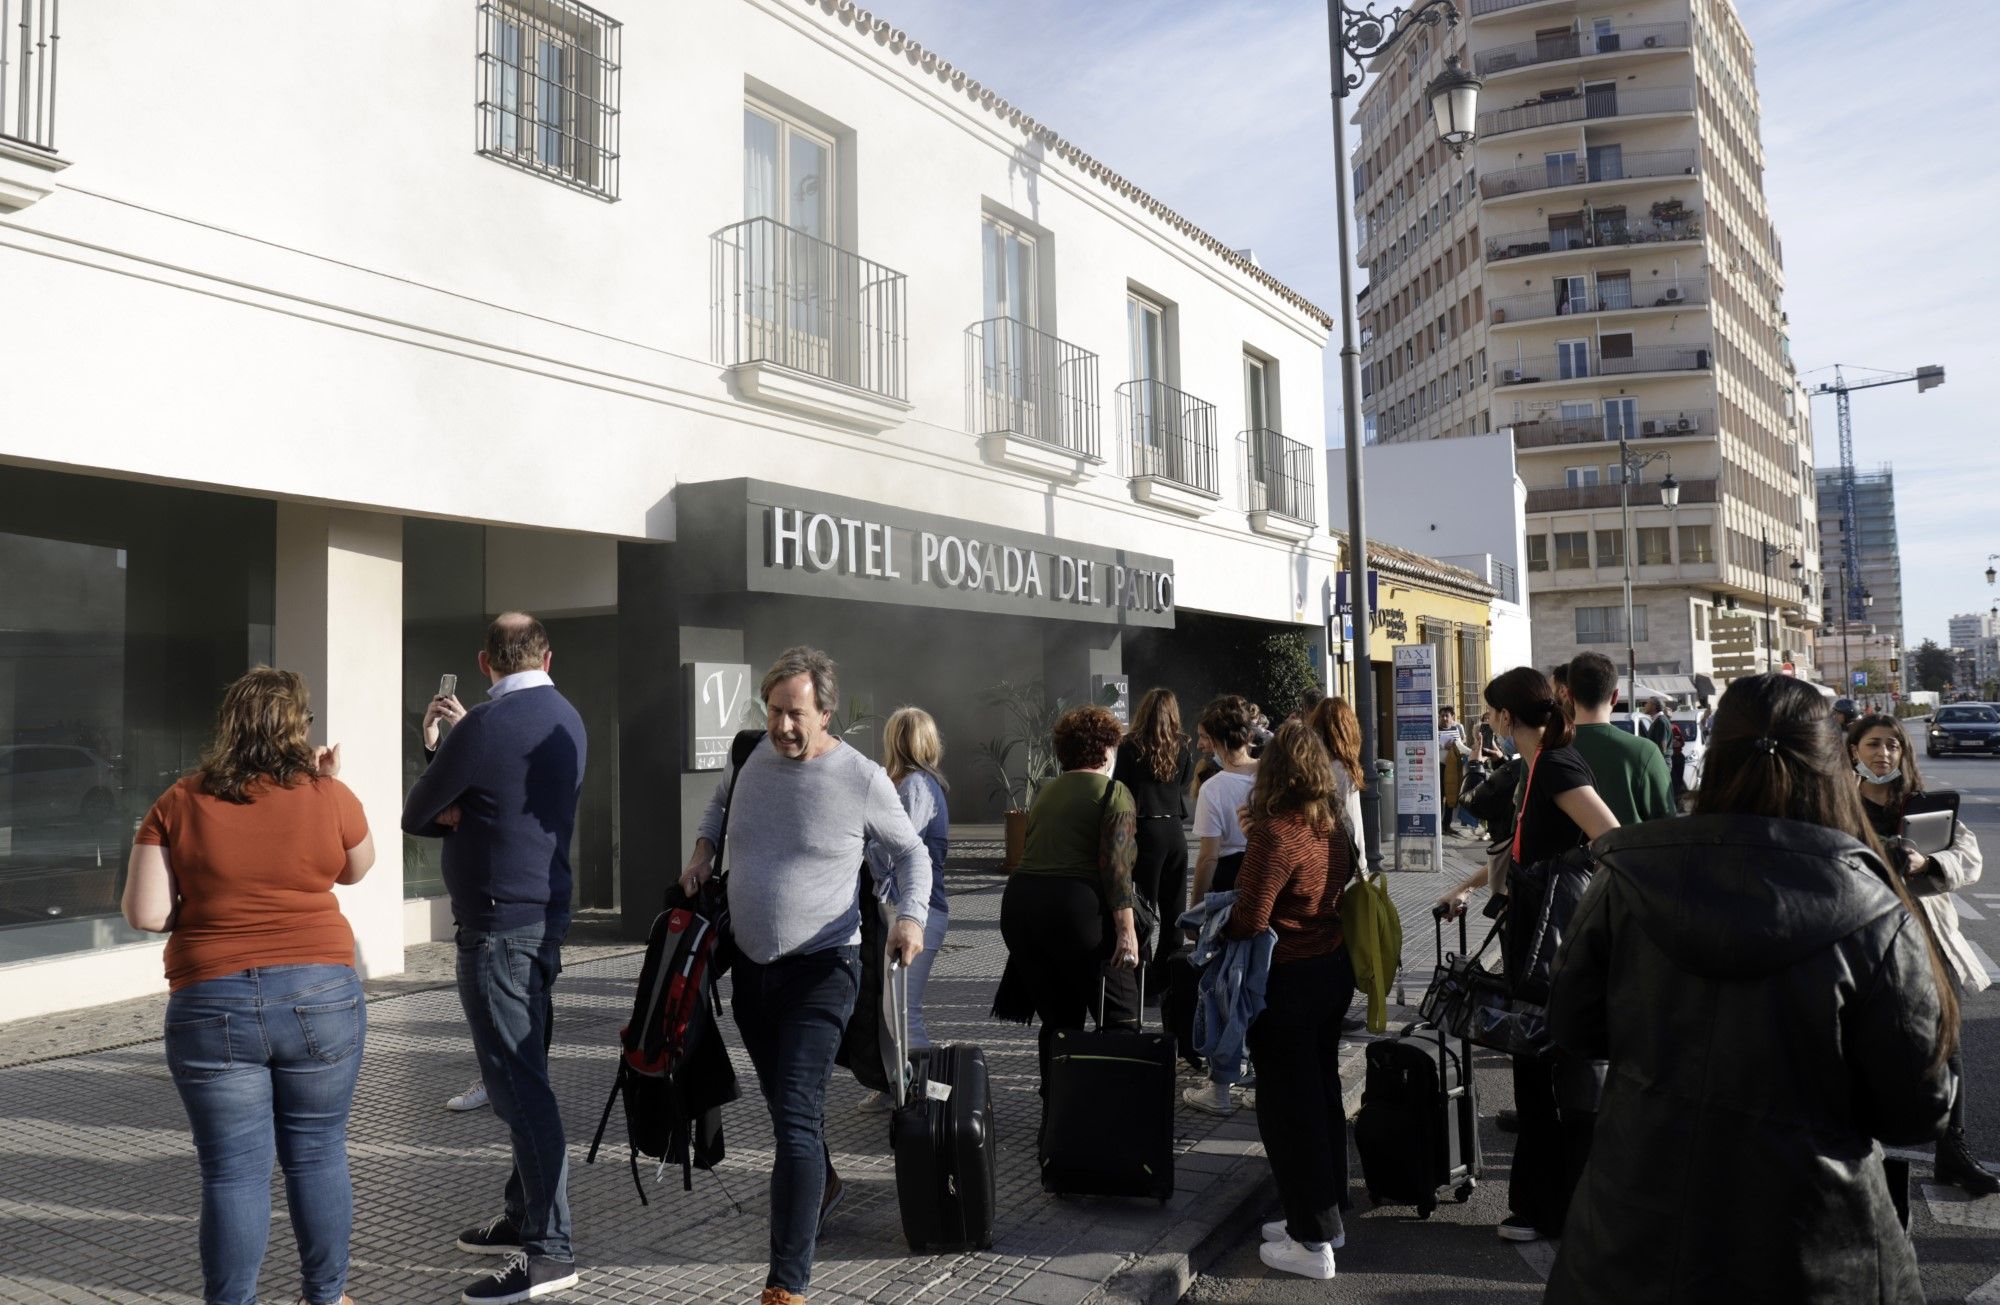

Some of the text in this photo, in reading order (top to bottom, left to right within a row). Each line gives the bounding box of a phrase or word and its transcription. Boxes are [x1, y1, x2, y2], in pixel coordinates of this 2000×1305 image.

[775, 507, 1173, 612] HOTEL POSADA DEL PATIO
[1398, 648, 1431, 659] TAXI
[703, 670, 743, 728] V
